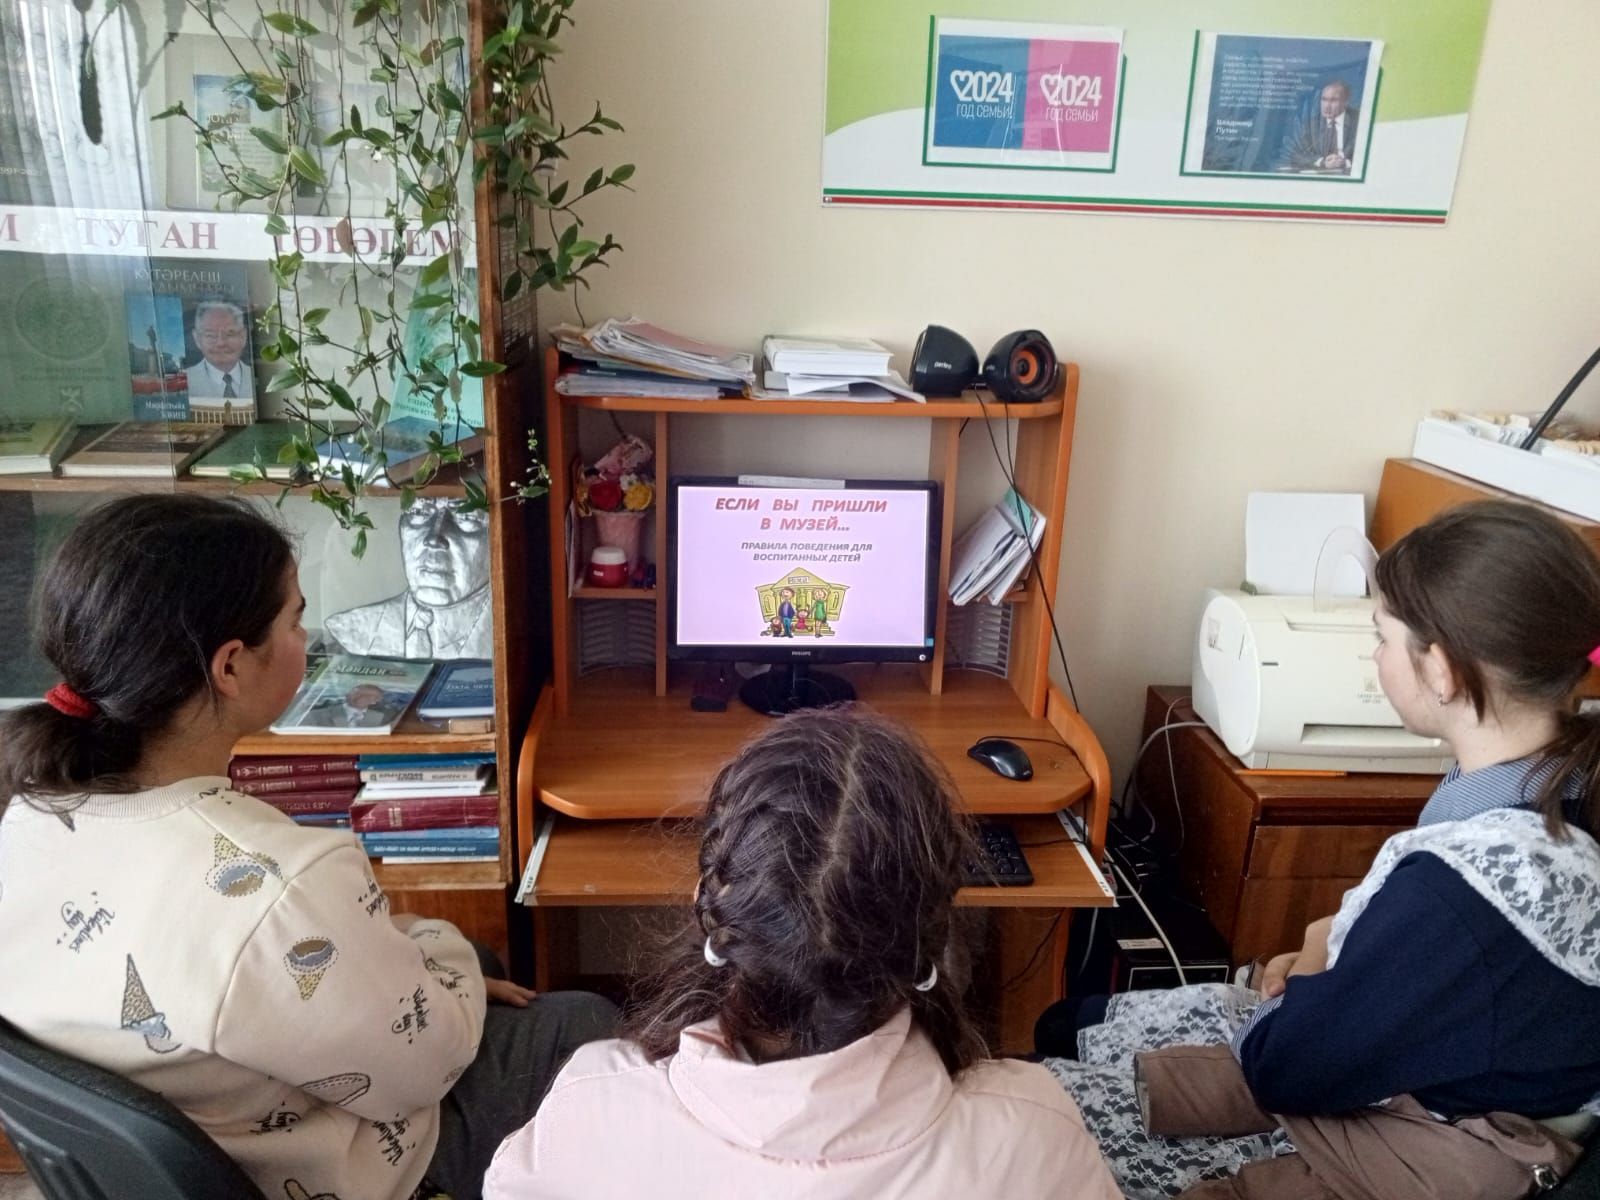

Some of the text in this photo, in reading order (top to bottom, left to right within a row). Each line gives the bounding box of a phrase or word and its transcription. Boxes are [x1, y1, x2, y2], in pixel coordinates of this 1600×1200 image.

[955, 70, 1014, 103] 2024
[1046, 74, 1102, 106] 2024
[76, 217, 218, 250] ТУГАН
[715, 498, 888, 513] ЕСЛИ ВЫ ПРИШЛИ
[760, 516, 850, 531] В МУЗЕЙ...
[741, 542, 873, 552] ПРАВИЛА ПОВЕДЕНИЯ ДЛЯ
[753, 553, 861, 563] ВОСПИТАННЫХ ДЕТЕЙ
